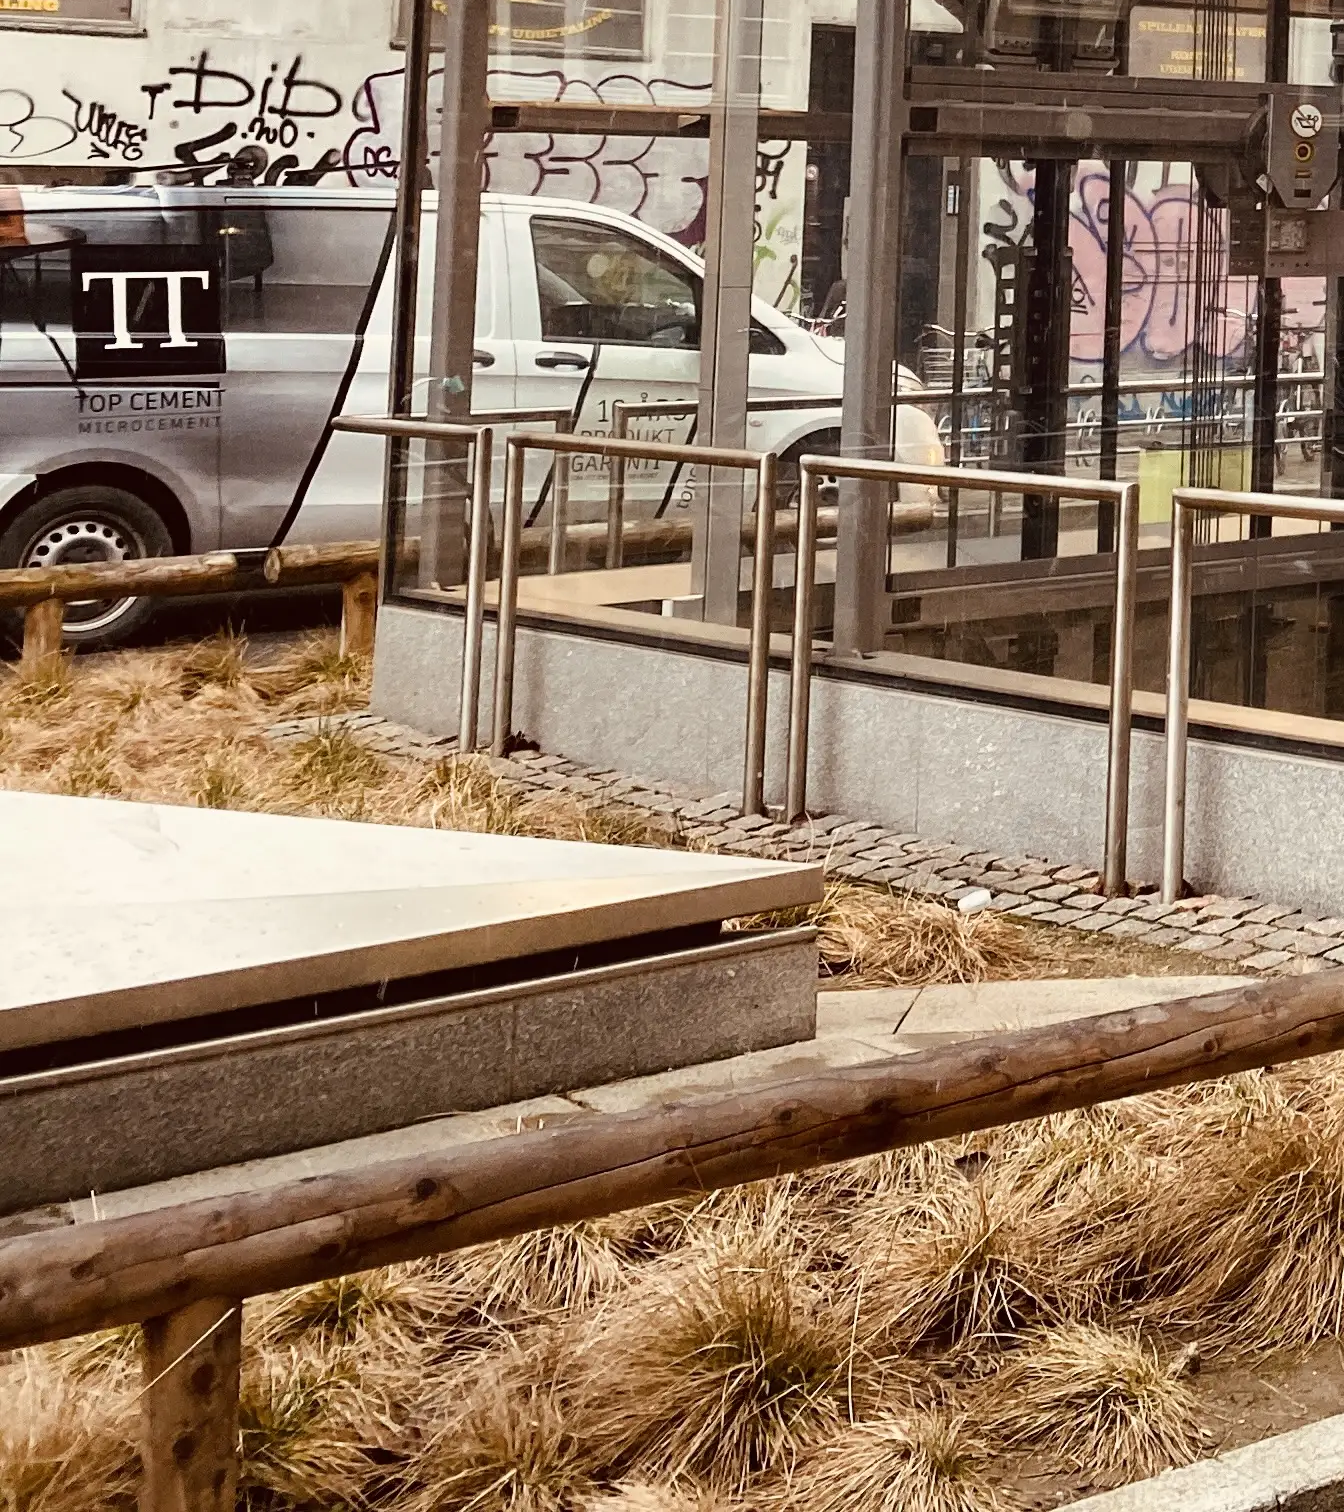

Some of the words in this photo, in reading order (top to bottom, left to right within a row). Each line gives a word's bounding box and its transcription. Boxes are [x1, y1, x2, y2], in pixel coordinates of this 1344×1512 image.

[76, 393, 123, 413] TOP
[129, 389, 226, 412] CEMENT
[78, 415, 222, 435] MICROCEMENT
[571, 453, 661, 473] GARNTI
